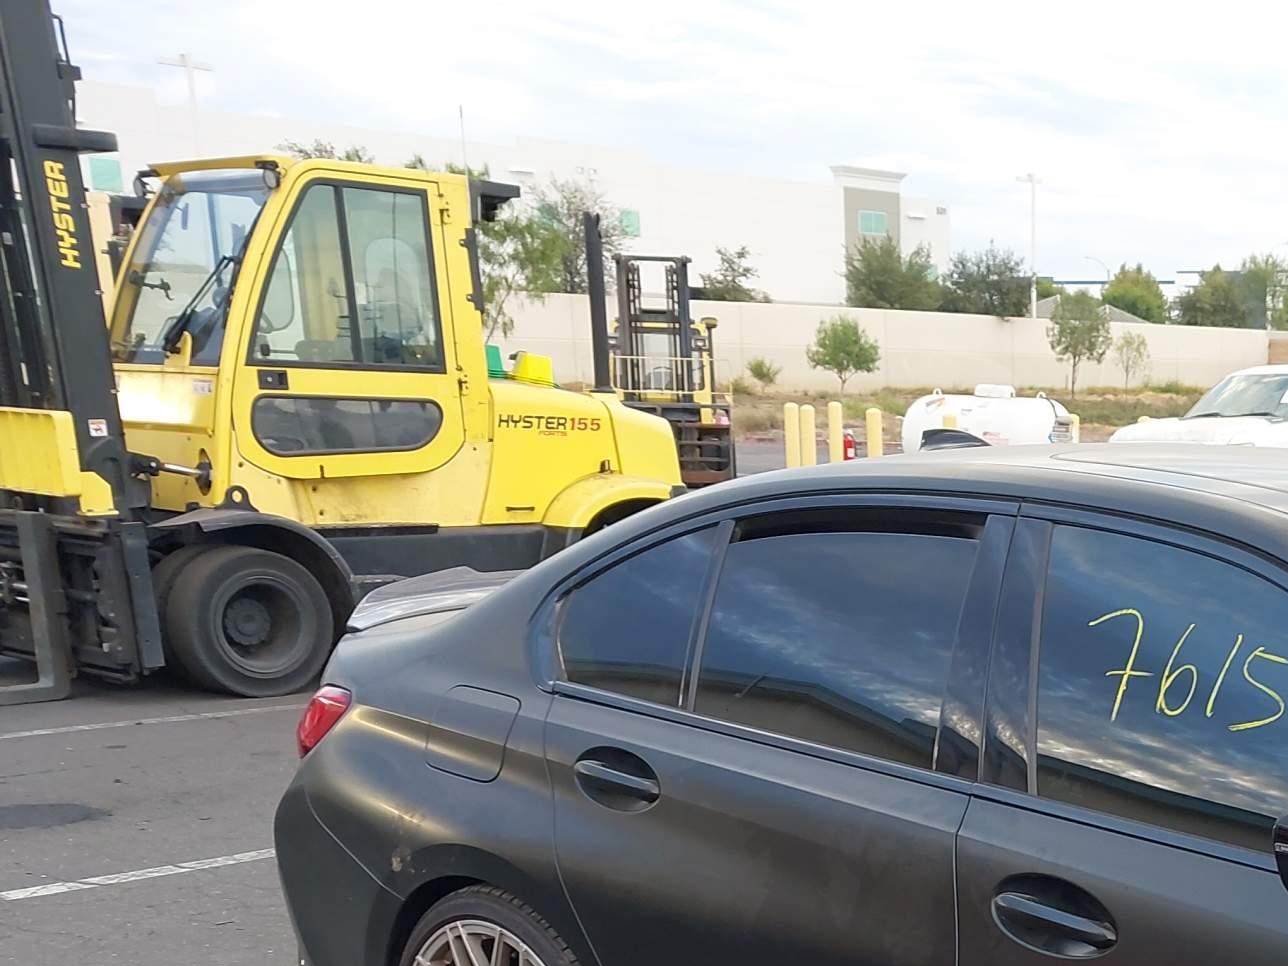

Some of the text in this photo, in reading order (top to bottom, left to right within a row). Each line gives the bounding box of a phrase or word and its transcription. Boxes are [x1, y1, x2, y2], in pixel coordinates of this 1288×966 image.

[43, 160, 82, 269] HYSTER
[497, 414, 601, 431] HYSTER 155
